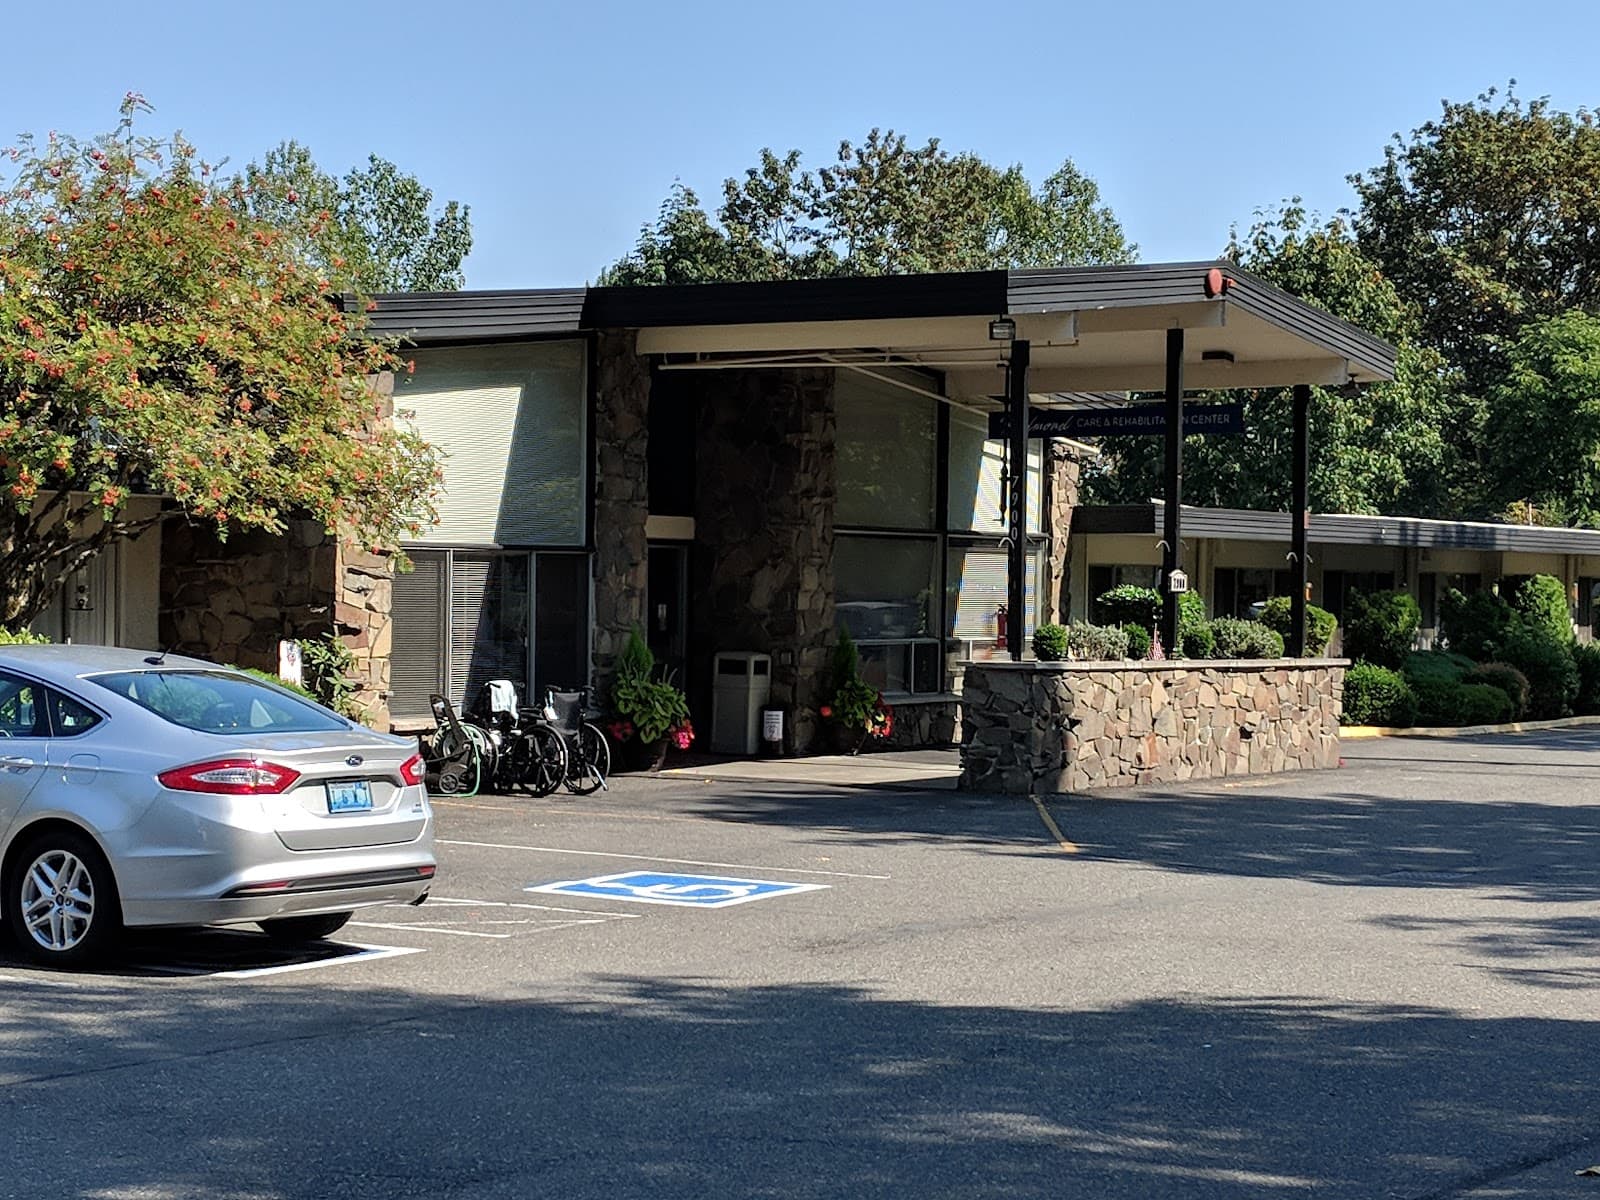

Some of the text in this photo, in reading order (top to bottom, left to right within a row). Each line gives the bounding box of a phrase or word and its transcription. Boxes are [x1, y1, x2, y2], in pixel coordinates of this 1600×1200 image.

[1076, 417, 1101, 428] CARE
[1112, 415, 1188, 427] REHABILITAN
[1191, 413, 1230, 425] CENTER
[1011, 475, 1019, 540] 7900
